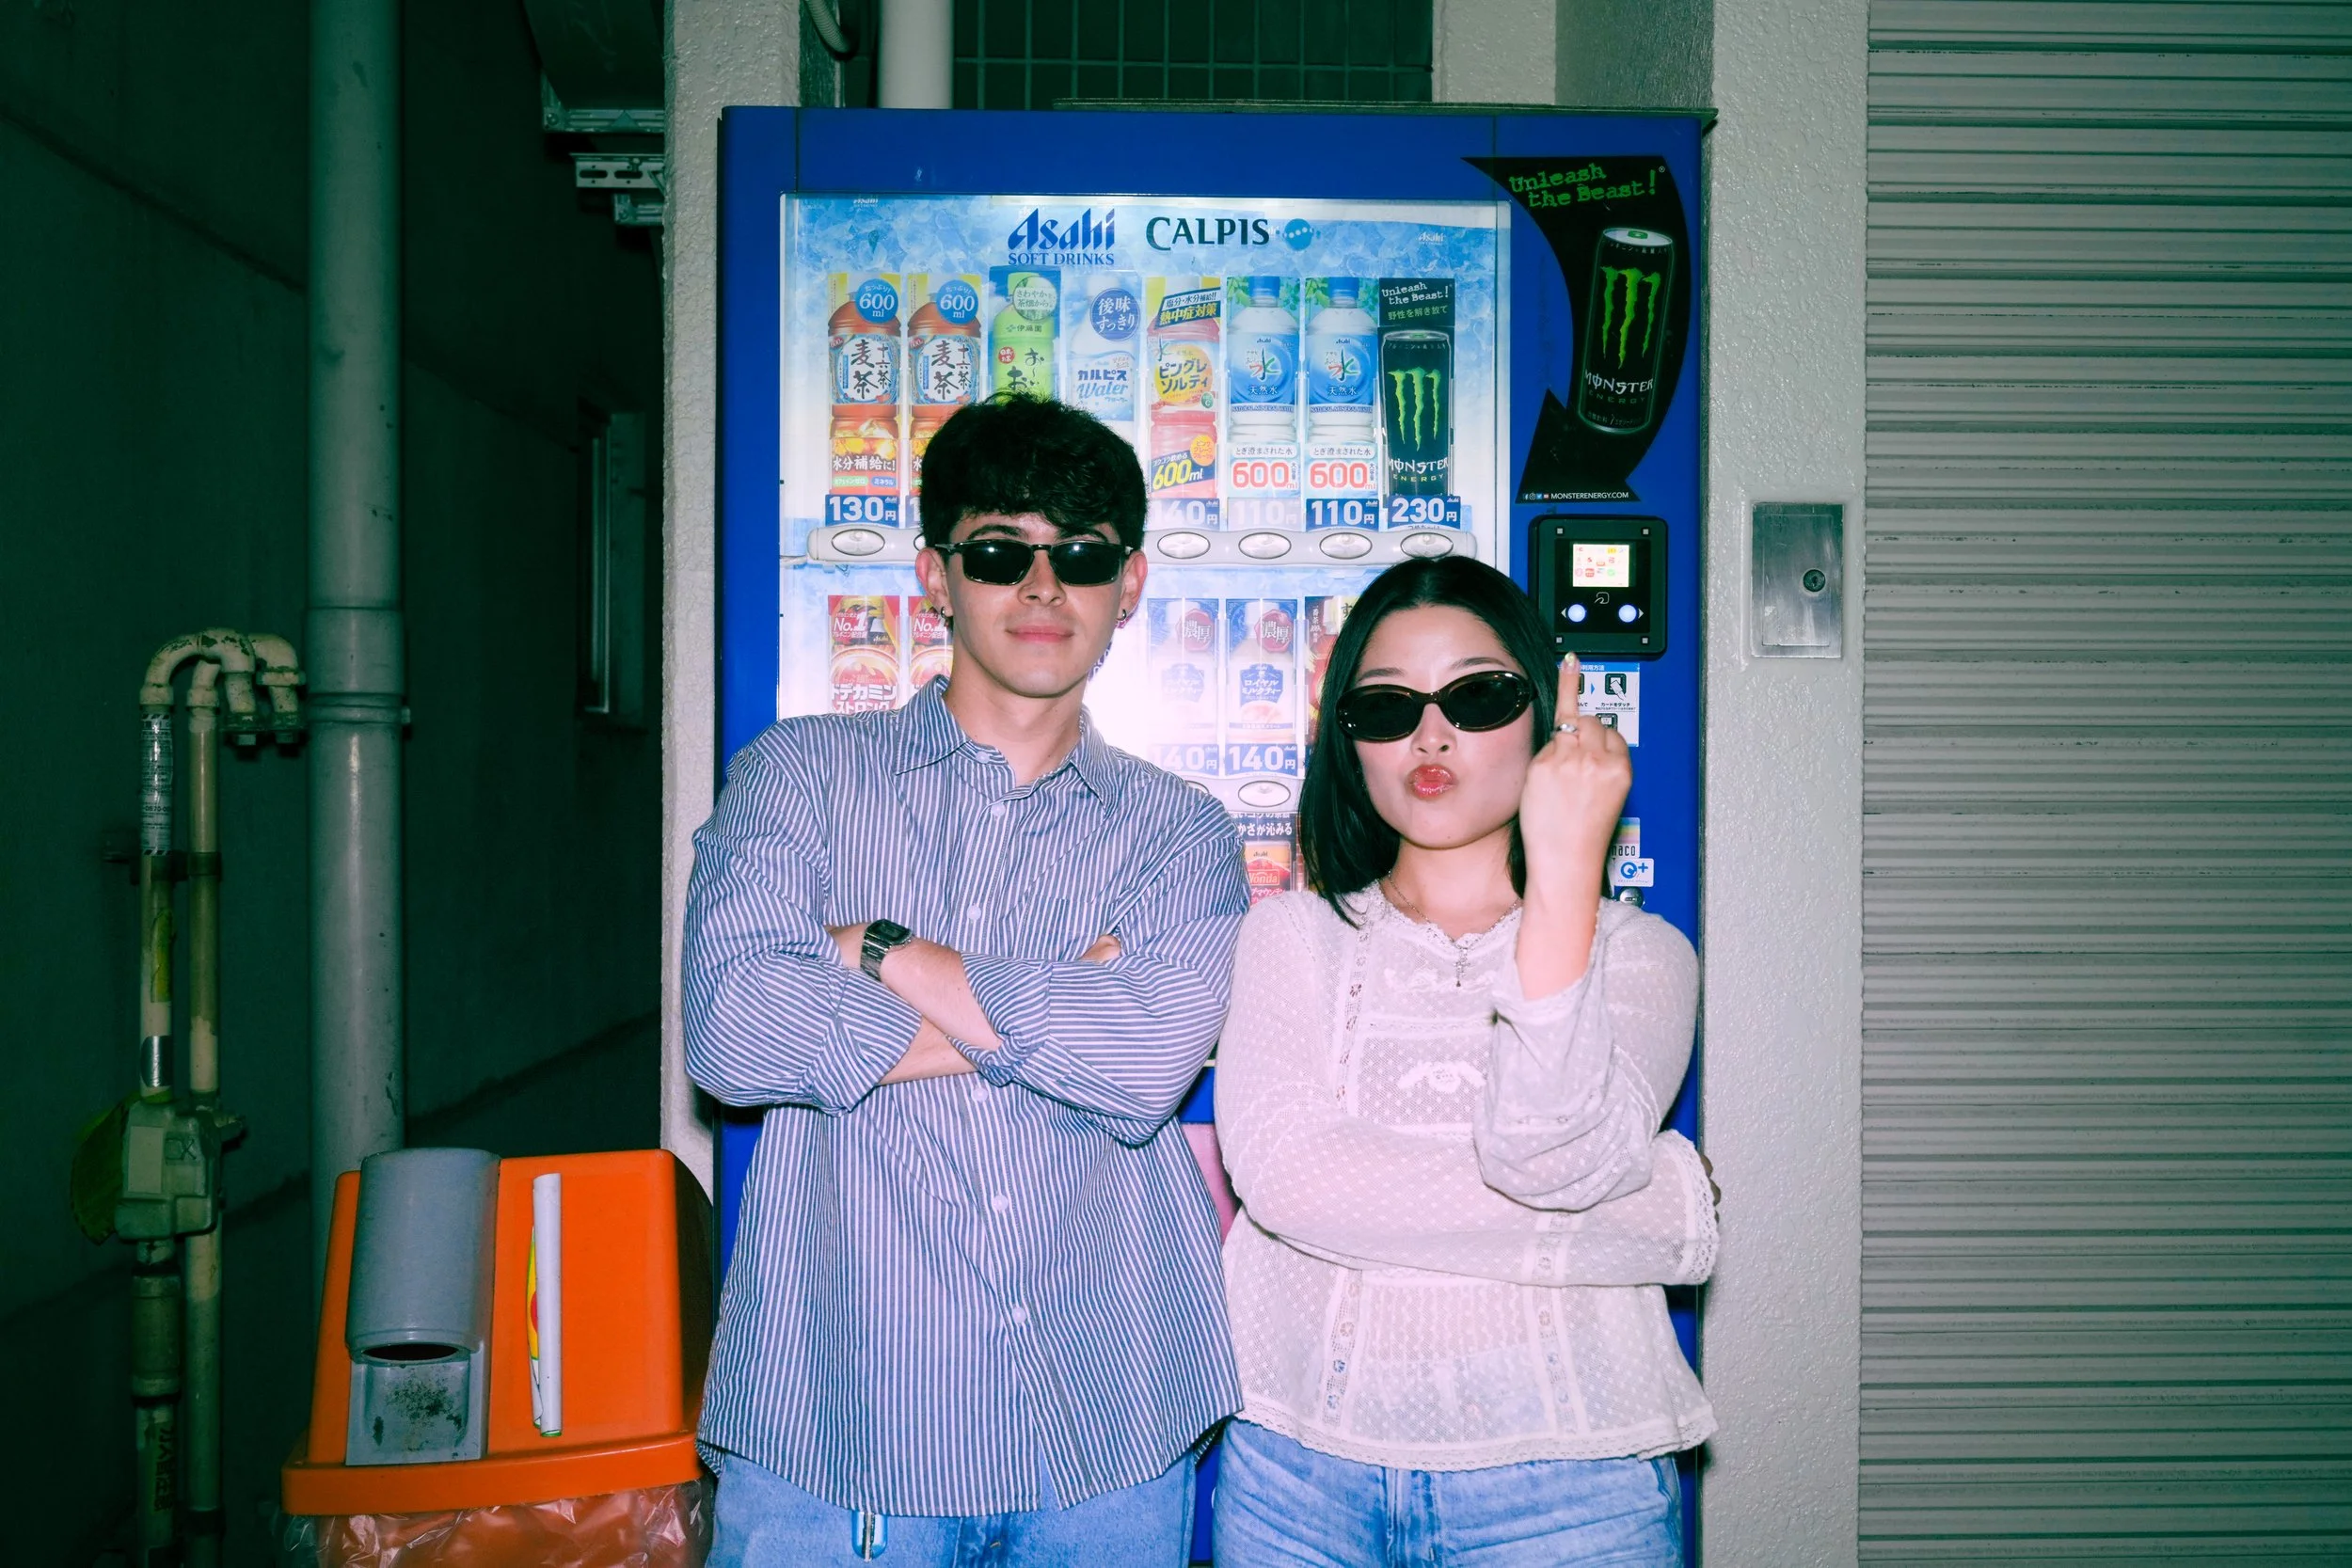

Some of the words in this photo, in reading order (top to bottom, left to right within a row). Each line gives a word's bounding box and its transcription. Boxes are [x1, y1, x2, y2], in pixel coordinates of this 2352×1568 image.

[1509, 162, 1607, 193] Unleash
[1528, 189, 1571, 208] the
[1576, 168, 1656, 202] Beast!
[1008, 208, 1115, 250] Asahi
[1146, 216, 1270, 251] CALPIS
[1008, 252, 1048, 265] SOFT
[1054, 252, 1115, 265] DRINKS
[1381, 282, 1427, 297] Unleash
[859, 293, 895, 310] 600
[940, 293, 975, 310] 600
[1098, 295, 1130, 316] 後味
[1389, 294, 1409, 305] the
[872, 309, 884, 318] ml
[953, 310, 965, 319] ml
[1160, 302, 1217, 325] 熱中症対策
[1388, 306, 1448, 320] 野性を解き放て
[1096, 314, 1135, 333] すっきり
[850, 340, 879, 399] 麦茶
[875, 343, 892, 388] 十六茶
[930, 341, 959, 400] 麦茶
[956, 344, 972, 389] 十六茶
[1077, 369, 1127, 381] カルピス
[1159, 359, 1207, 379] ピングレ
[1076, 381, 1129, 399] Water
[1161, 375, 1208, 394] ソルティ
[1249, 385, 1278, 396] 天然水
[1328, 386, 1358, 396] 天然水
[1584, 369, 1654, 395] MONSTER
[1588, 390, 1645, 404] ENERGY
[1235, 447, 1294, 455] とぎ澄まされた水
[1313, 447, 1372, 455] とぎ澄まされた水
[833, 455, 896, 471] 水分補給に!
[1152, 460, 1192, 490] 600
[1189, 468, 1202, 481] ml
[1232, 462, 1289, 488] 600
[1311, 462, 1368, 488] 600
[1393, 473, 1443, 483] ENERGY
[1550, 492, 1629, 500] MONSTERENERGY.COM
[834, 612, 867, 632] No.1
[1184, 620, 1211, 643] 濃厚
[1263, 622, 1290, 643] 濃厚
[1229, 746, 1295, 770] 140円
